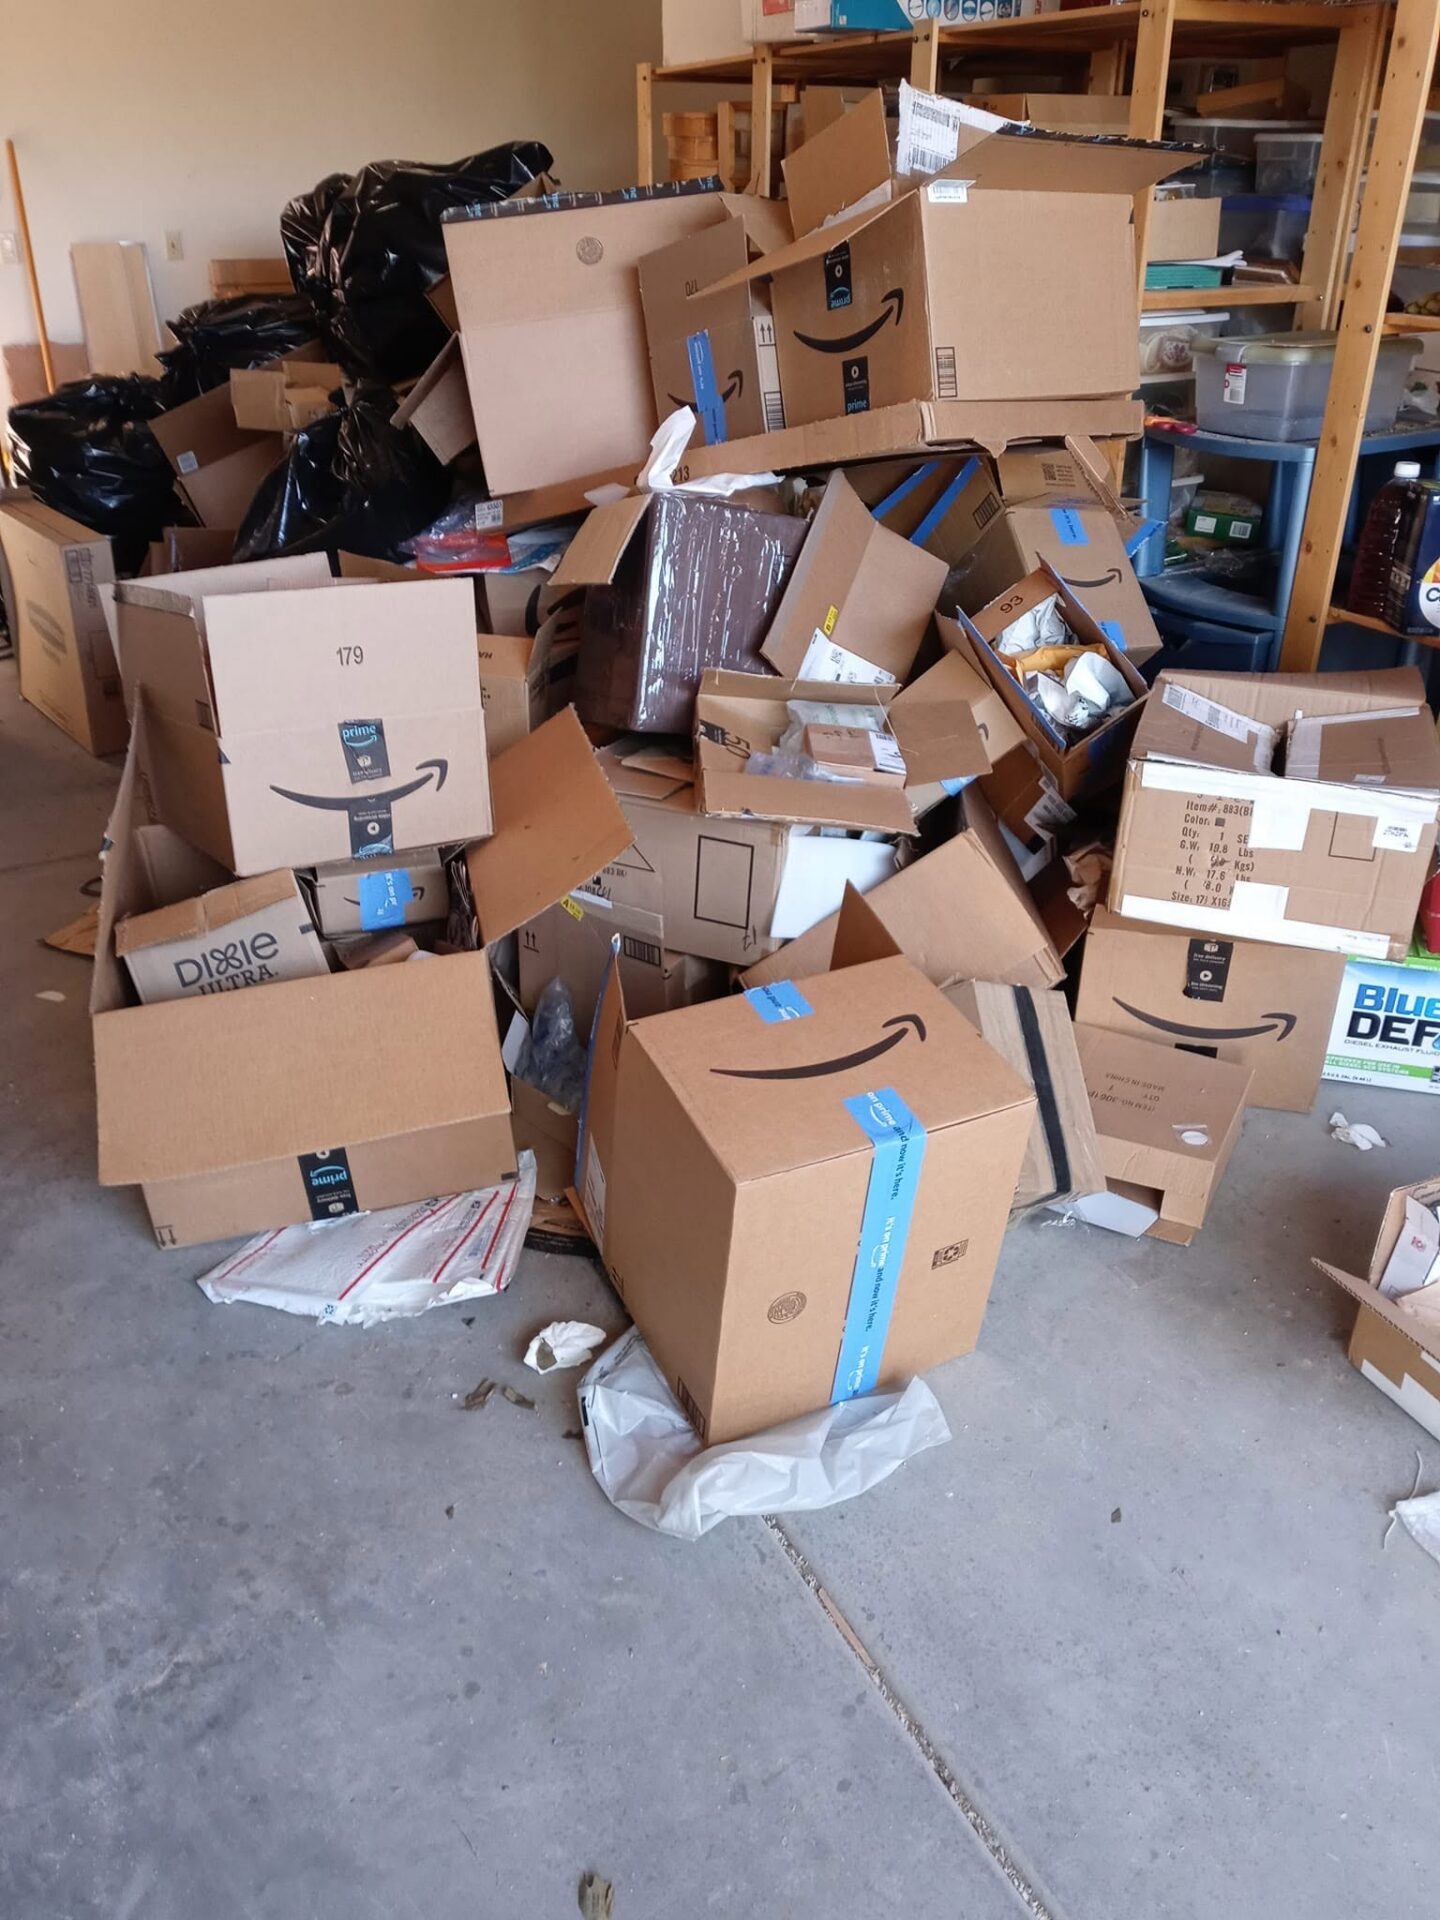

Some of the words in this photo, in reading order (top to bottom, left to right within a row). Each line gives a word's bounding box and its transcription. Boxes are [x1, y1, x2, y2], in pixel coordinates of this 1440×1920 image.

[847, 398, 867, 414] prime
[1000, 595, 1024, 614] 93
[336, 645, 364, 666] 179
[342, 724, 377, 740] prime
[1184, 813, 1210, 826] Color:
[1182, 826, 1200, 839] Qty:
[1238, 847, 1254, 858] Lbs
[1234, 860, 1255, 872] Kgs)
[1206, 869, 1226, 880] 17.6
[1171, 891, 1193, 903] Size:
[1353, 983, 1440, 1019] Blue
[1346, 1010, 1440, 1047] DEF
[1344, 1038, 1374, 1049] DIESEL
[1375, 1042, 1415, 1053] EXHAUST
[874, 1101, 897, 1126] prime
[893, 1126, 909, 1142] and
[898, 1144, 907, 1162] now
[311, 1169, 348, 1186] prime
[895, 1162, 906, 1177] it's
[890, 1177, 903, 1200] here.
[883, 1231, 892, 1243] on
[878, 1243, 890, 1267] prime
[875, 1266, 885, 1283] and
[872, 1283, 881, 1298] now
[865, 1311, 877, 1332] here.
